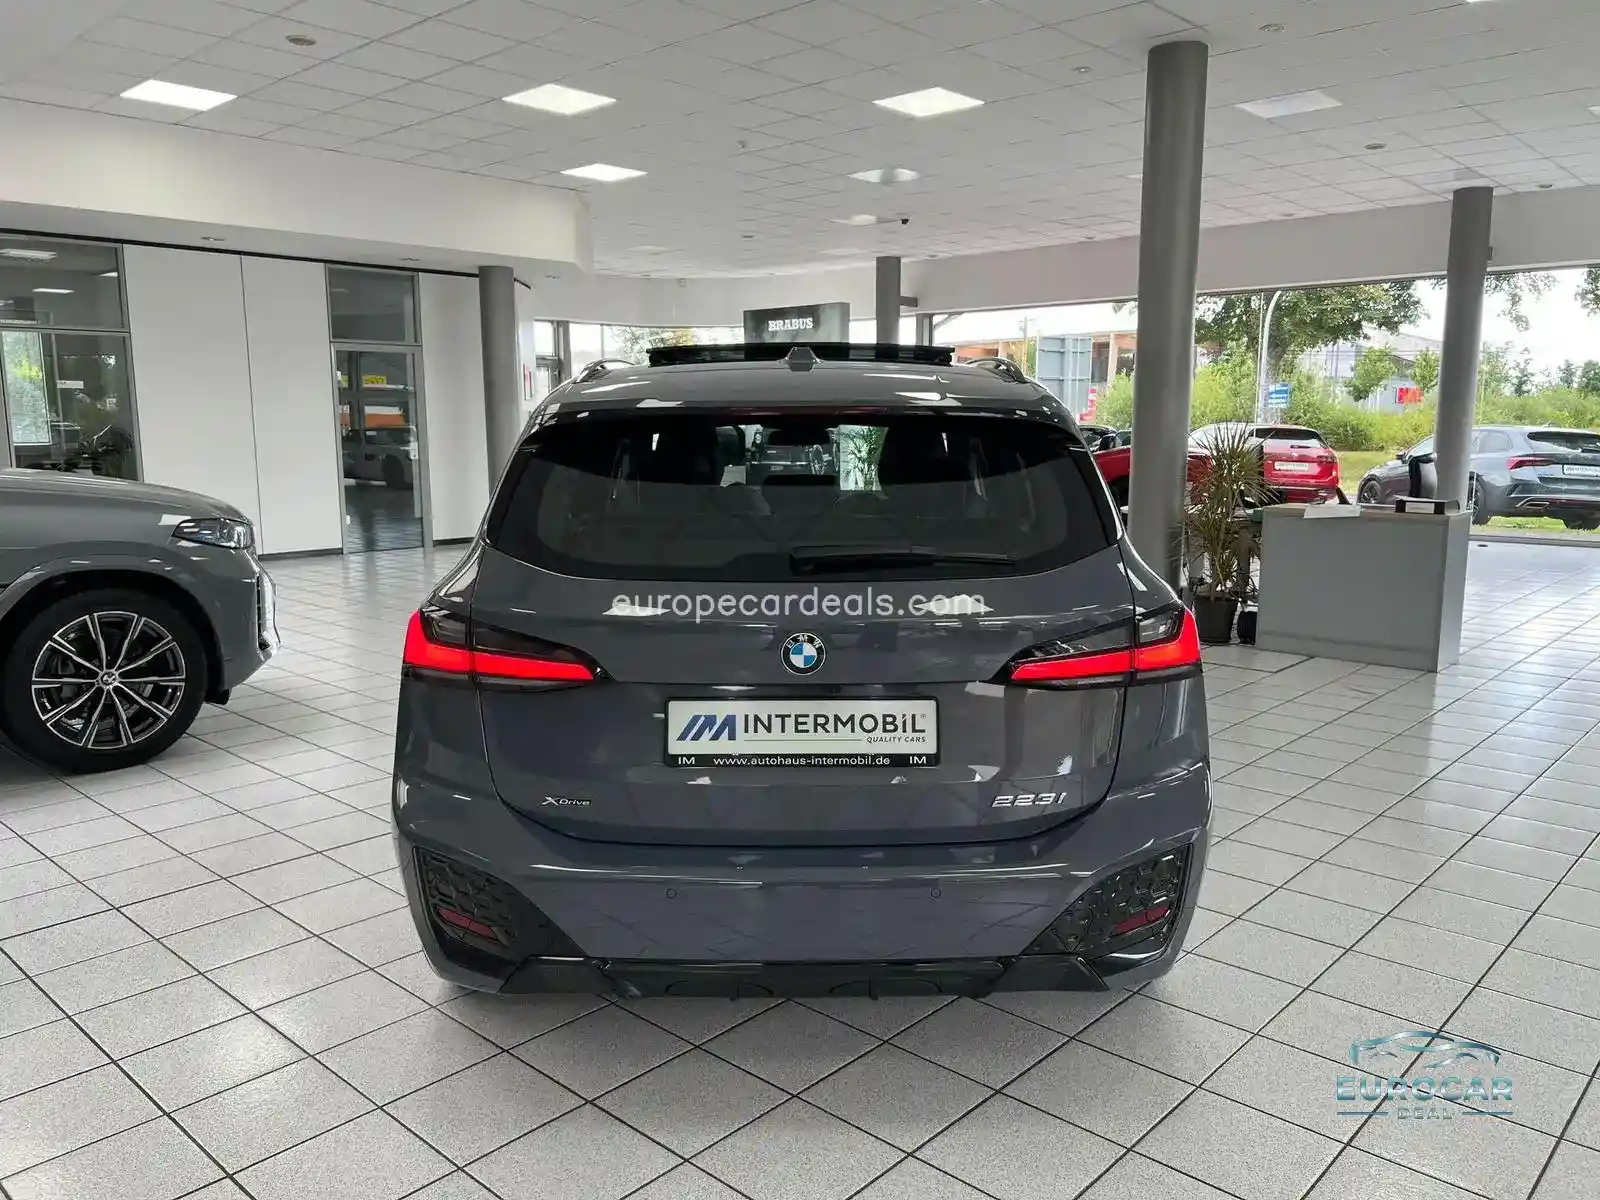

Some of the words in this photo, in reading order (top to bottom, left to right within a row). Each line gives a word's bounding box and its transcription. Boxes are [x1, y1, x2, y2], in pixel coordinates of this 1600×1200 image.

[768, 318, 813, 332] BRABUS
[785, 634, 822, 649] BMW
[866, 736, 902, 744] QUALITY
[678, 756, 696, 765] IM
[713, 756, 891, 766] www.autohaus-intermobil.de
[909, 755, 927, 764] IM
